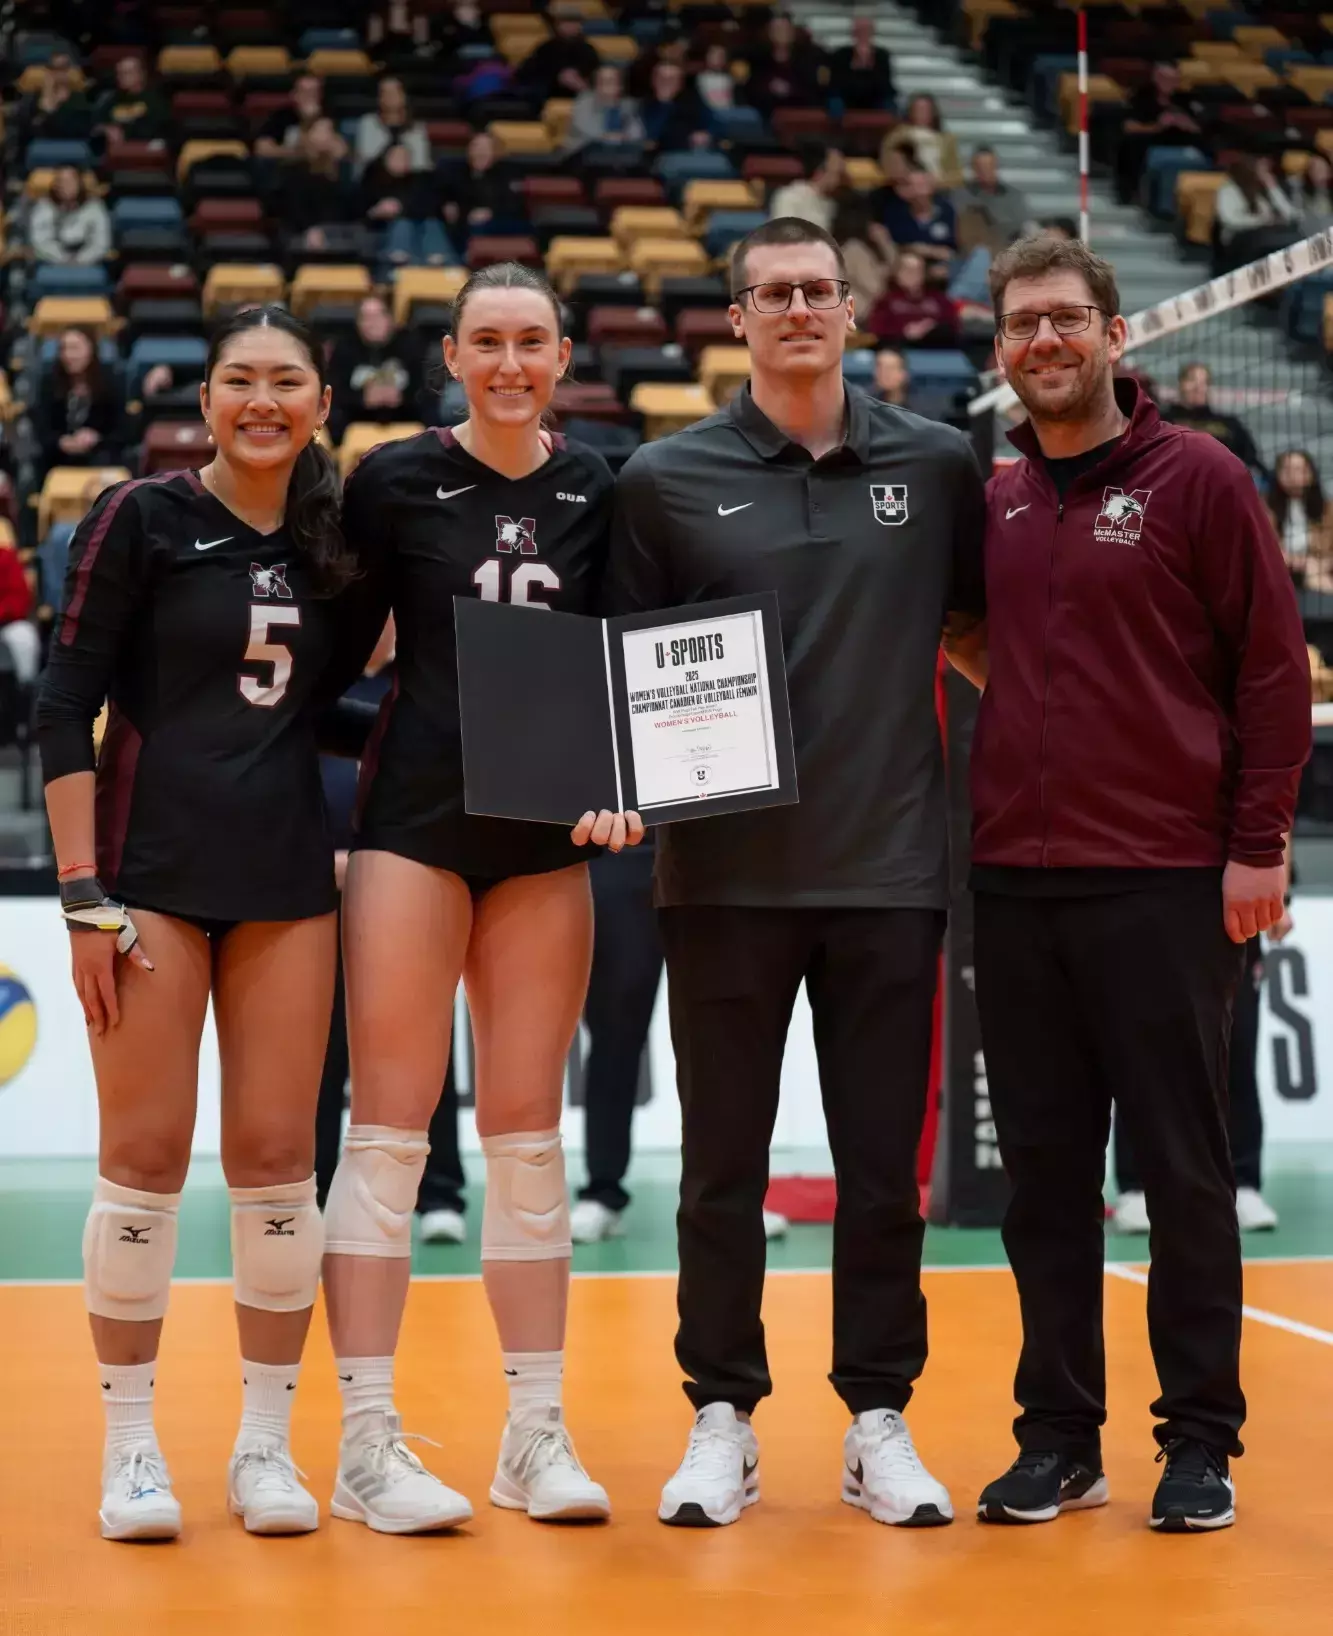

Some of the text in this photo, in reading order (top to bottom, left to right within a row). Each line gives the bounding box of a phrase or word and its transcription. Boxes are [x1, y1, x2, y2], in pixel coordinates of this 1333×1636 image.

[555, 491, 588, 502] OUA
[875, 501, 906, 510] SPORTS
[1093, 529, 1141, 541] McMASTER
[1095, 536, 1136, 547] VOLLEYBALL
[239, 603, 300, 707] 5
[670, 633, 724, 667] SPORTS
[685, 670, 699, 682] 2025
[629, 673, 757, 703] WOMEN'S VOLLEYBALL NATIONAL CHAMPIONSHIP
[631, 699, 669, 714] CHAMPIONNAT
[669, 696, 695, 709] CANADIEN
[695, 694, 703, 705] DE
[703, 690, 736, 704] VOLLEYBALL
[654, 717, 689, 729] WOMEN'S
[690, 710, 738, 724] VOLLEYBALL
